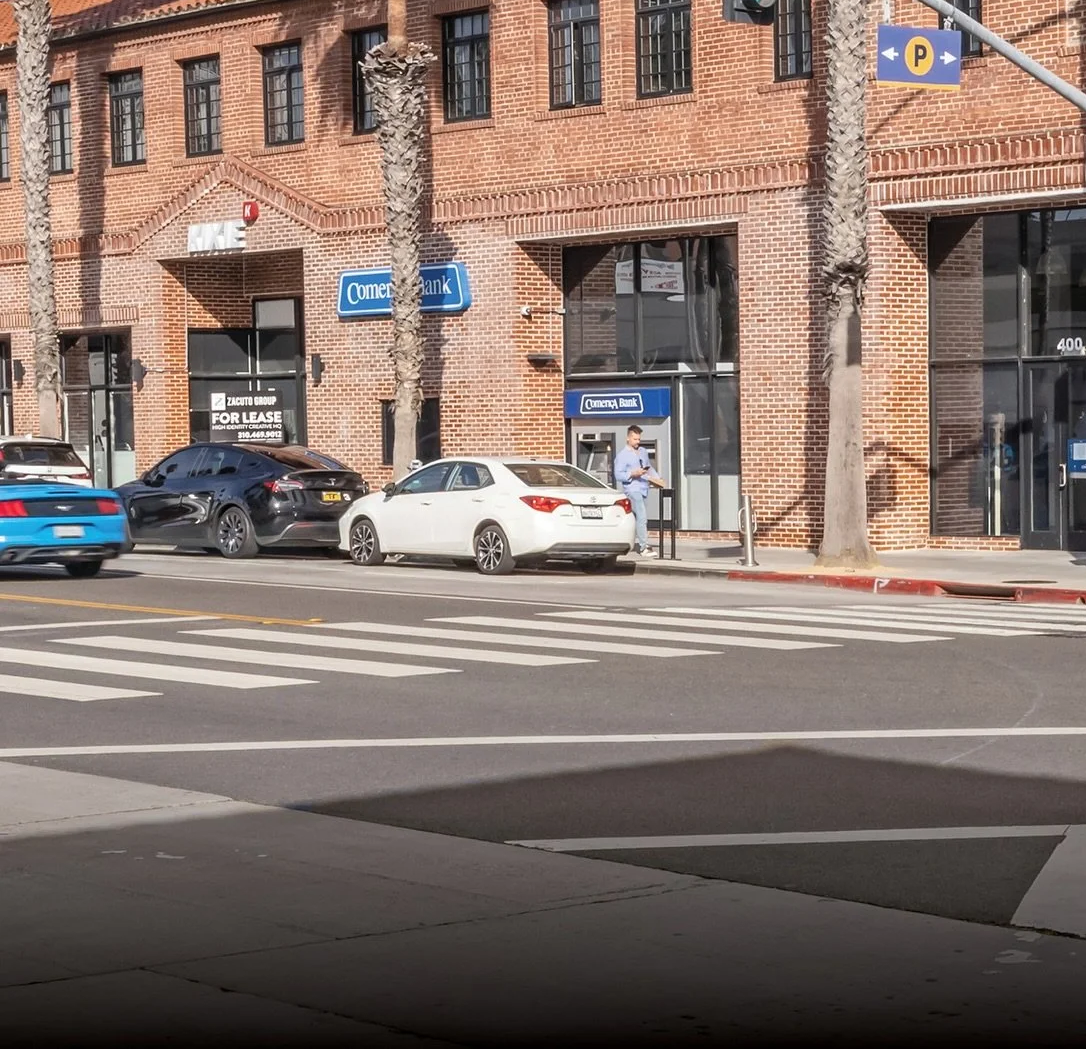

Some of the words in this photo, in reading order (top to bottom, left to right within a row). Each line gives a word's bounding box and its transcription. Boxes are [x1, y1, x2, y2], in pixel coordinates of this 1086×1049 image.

[913, 44, 928, 68] P
[244, 204, 252, 218] K
[1056, 337, 1083, 352] 400
[226, 397, 253, 407] ZACUTO
[254, 396, 277, 406] GROUP
[619, 397, 638, 408] Bank
[211, 411, 240, 424] FOR
[242, 411, 282, 424] LEASE
